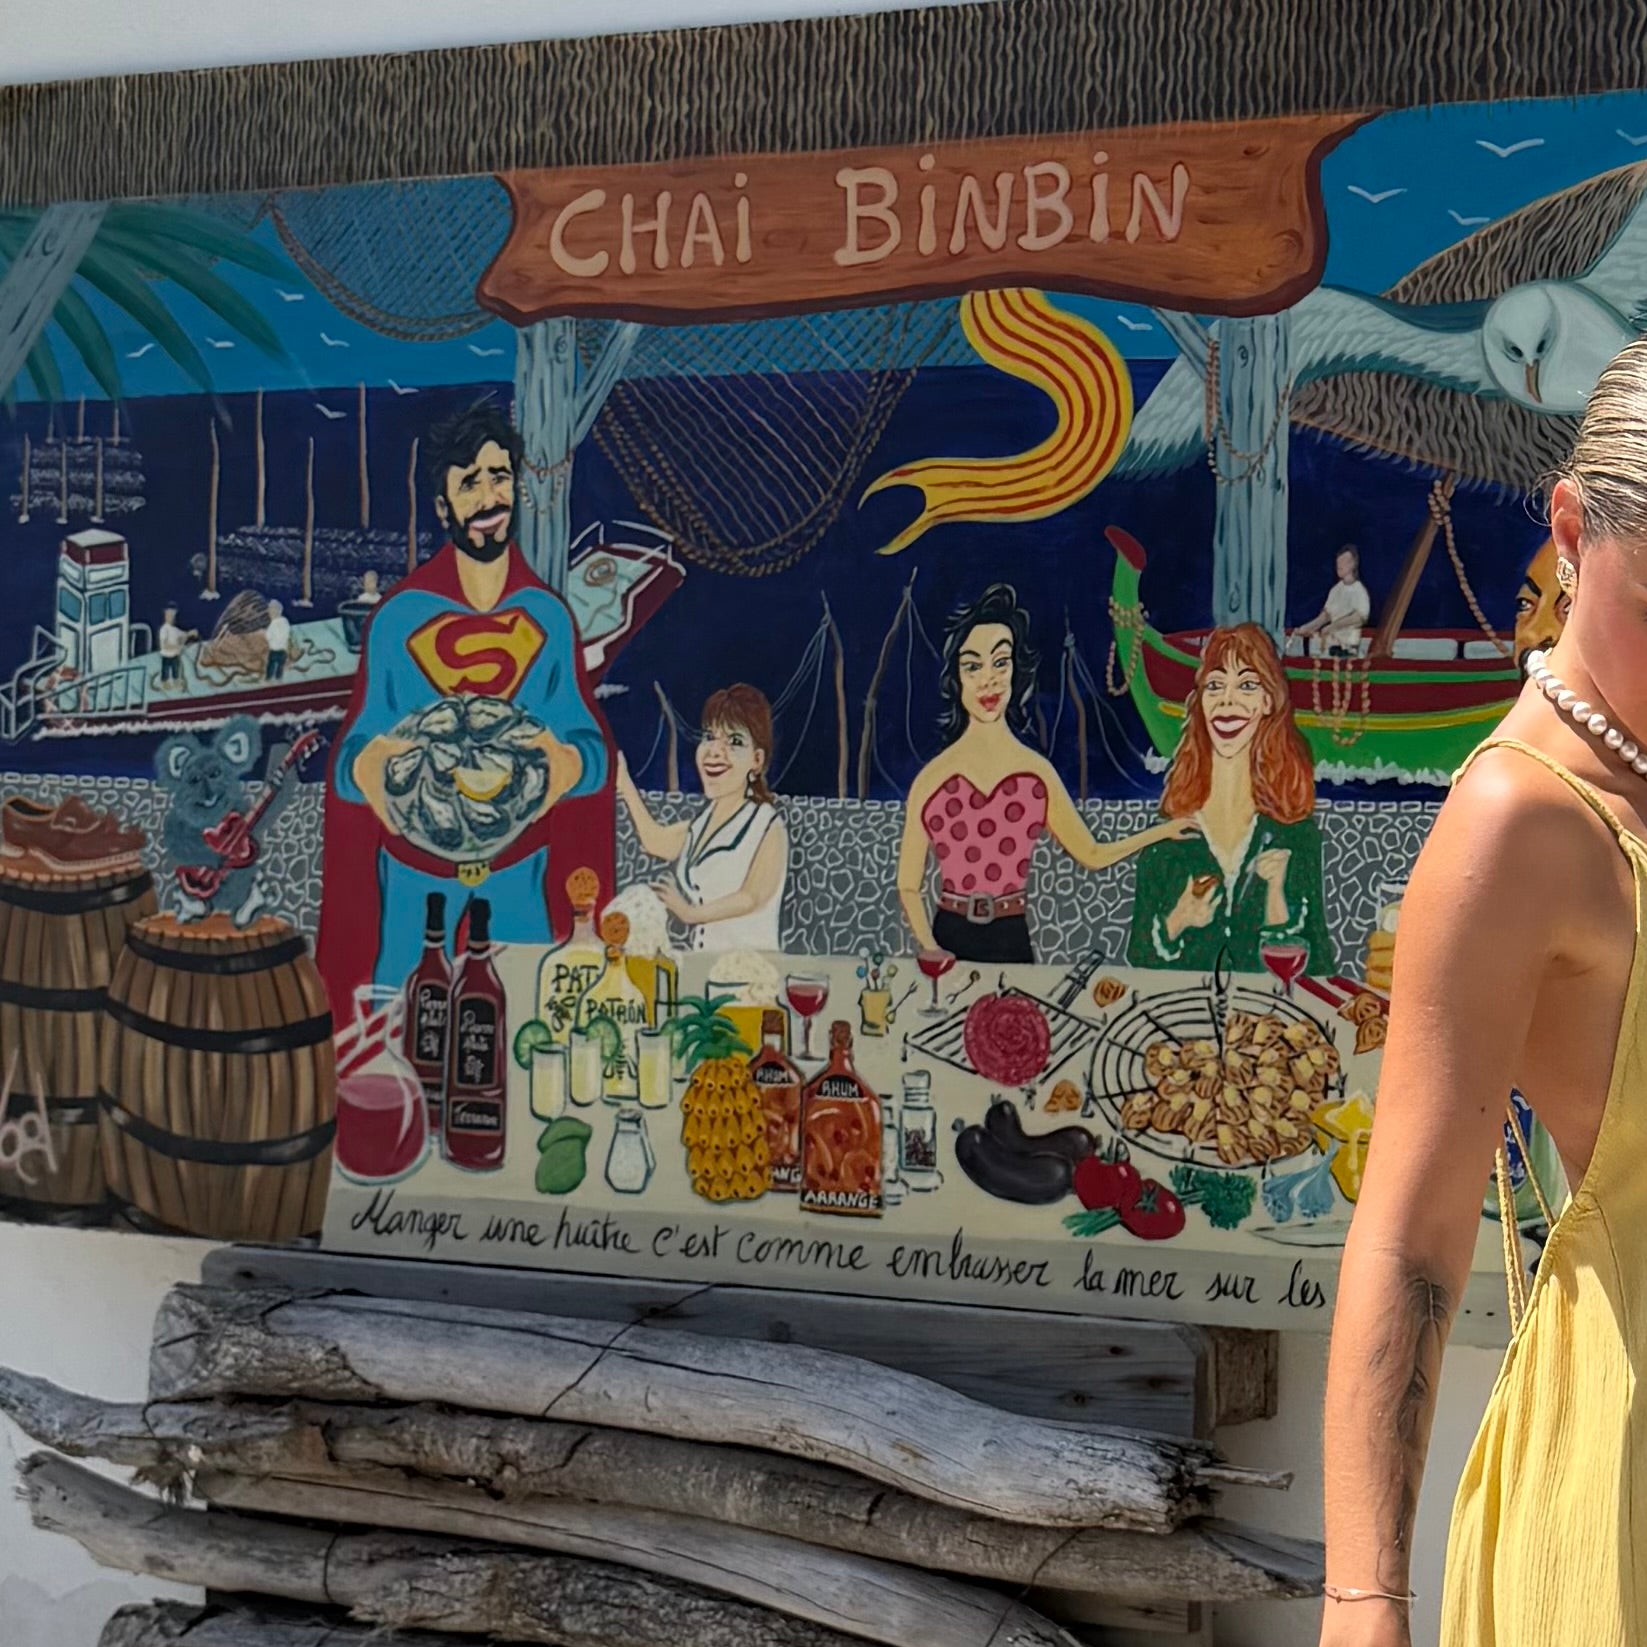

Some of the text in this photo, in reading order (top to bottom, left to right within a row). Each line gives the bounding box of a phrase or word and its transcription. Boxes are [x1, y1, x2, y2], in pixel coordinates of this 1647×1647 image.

[822, 1080, 860, 1097] RHUM
[351, 1187, 470, 1251] Manger
[479, 1215, 546, 1247] une
[886, 1226, 1053, 1287] embrasser
[1073, 1249, 1107, 1292] la
[1112, 1267, 1185, 1300] mer
[1205, 1272, 1261, 1303] sur
[1278, 1258, 1327, 1309] les
